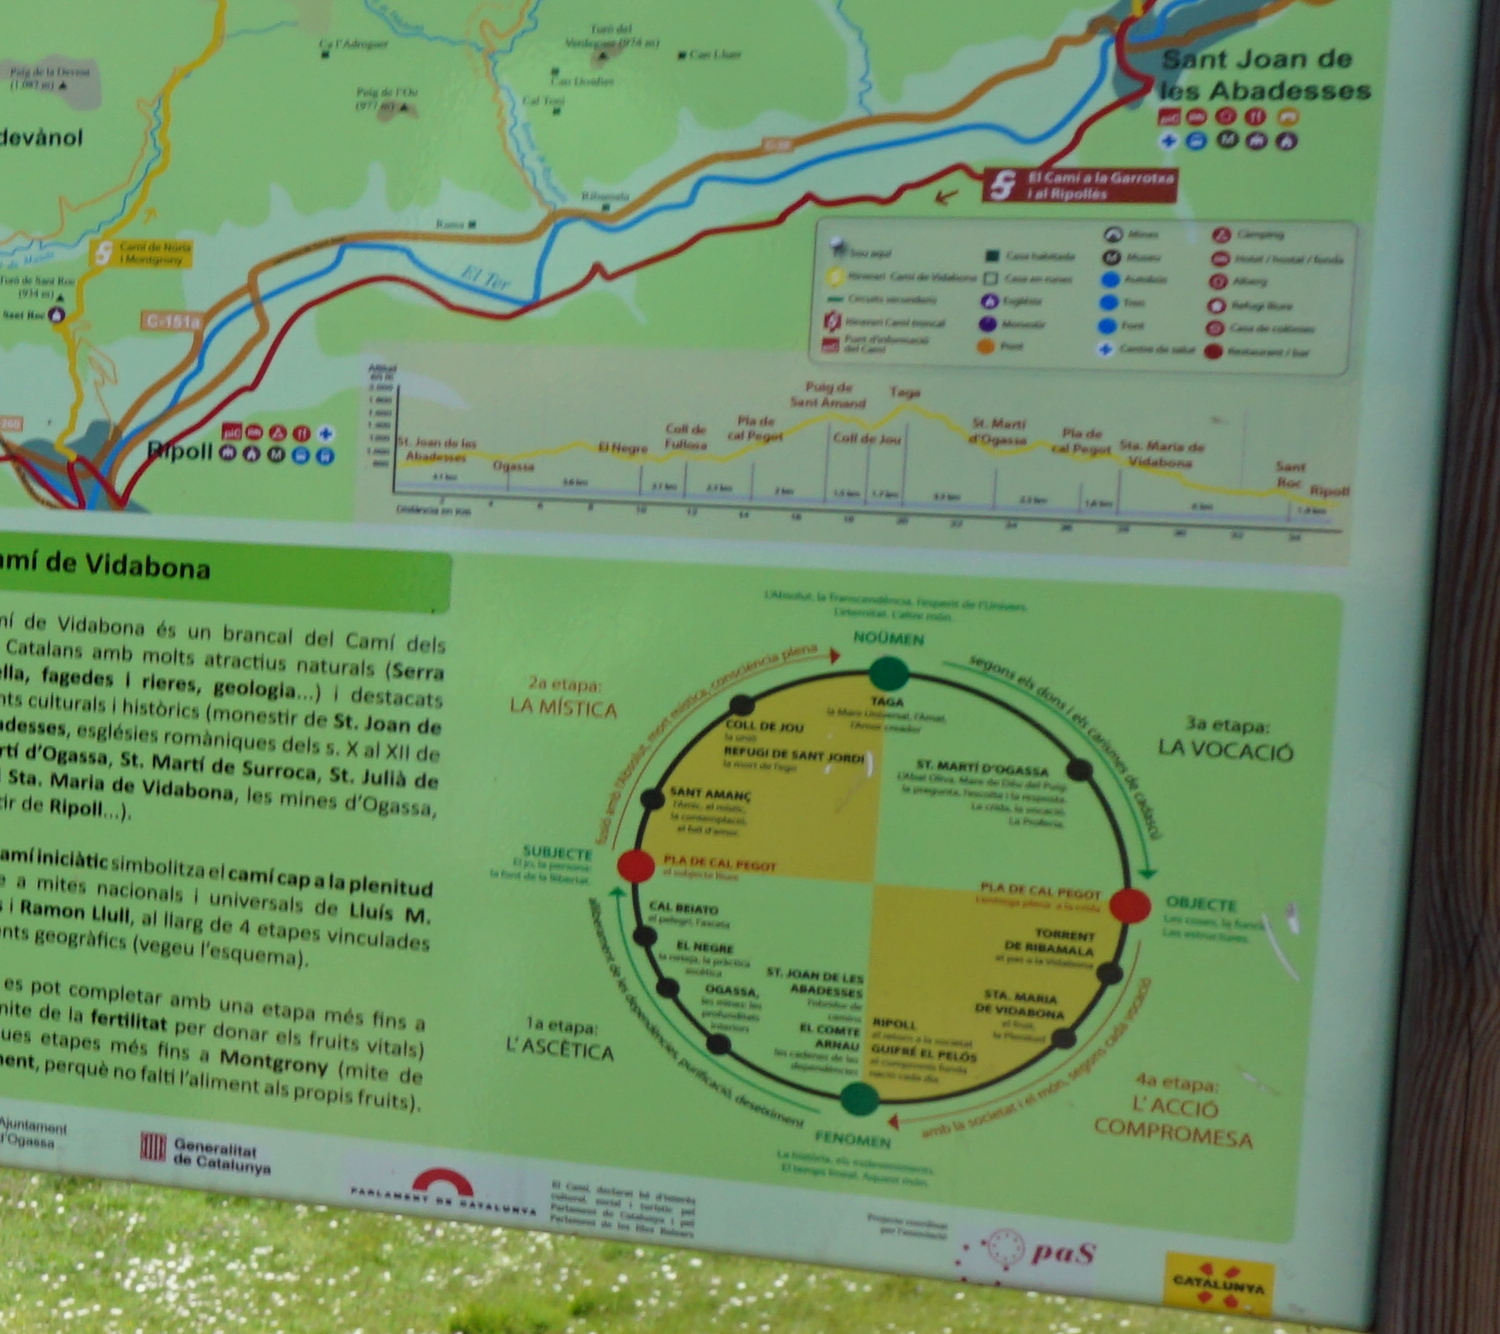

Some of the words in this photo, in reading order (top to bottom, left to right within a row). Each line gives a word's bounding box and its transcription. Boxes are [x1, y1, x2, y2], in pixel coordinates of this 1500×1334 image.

[1163, 46, 1228, 70] Sant
[1235, 48, 1308, 70] Joan
[1317, 48, 1353, 69] de
[1159, 80, 1201, 101] les
[1208, 80, 1372, 101] Abadesses
[45, 549, 77, 573] de
[85, 552, 211, 580] Vidabona
[509, 696, 533, 714] LA
[538, 697, 618, 718] MÍSTICA
[1157, 737, 1185, 756] LA
[1190, 740, 1295, 763] VOCACIÓ
[521, 1038, 615, 1061] ASCÈTICA
[1149, 1090, 1219, 1119] ACCIÓ
[1093, 1117, 1253, 1148] COMPROMESA
[174, 1138, 257, 1160] Generalitat
[174, 1152, 191, 1165] de
[196, 1153, 271, 1177] Catalunya
